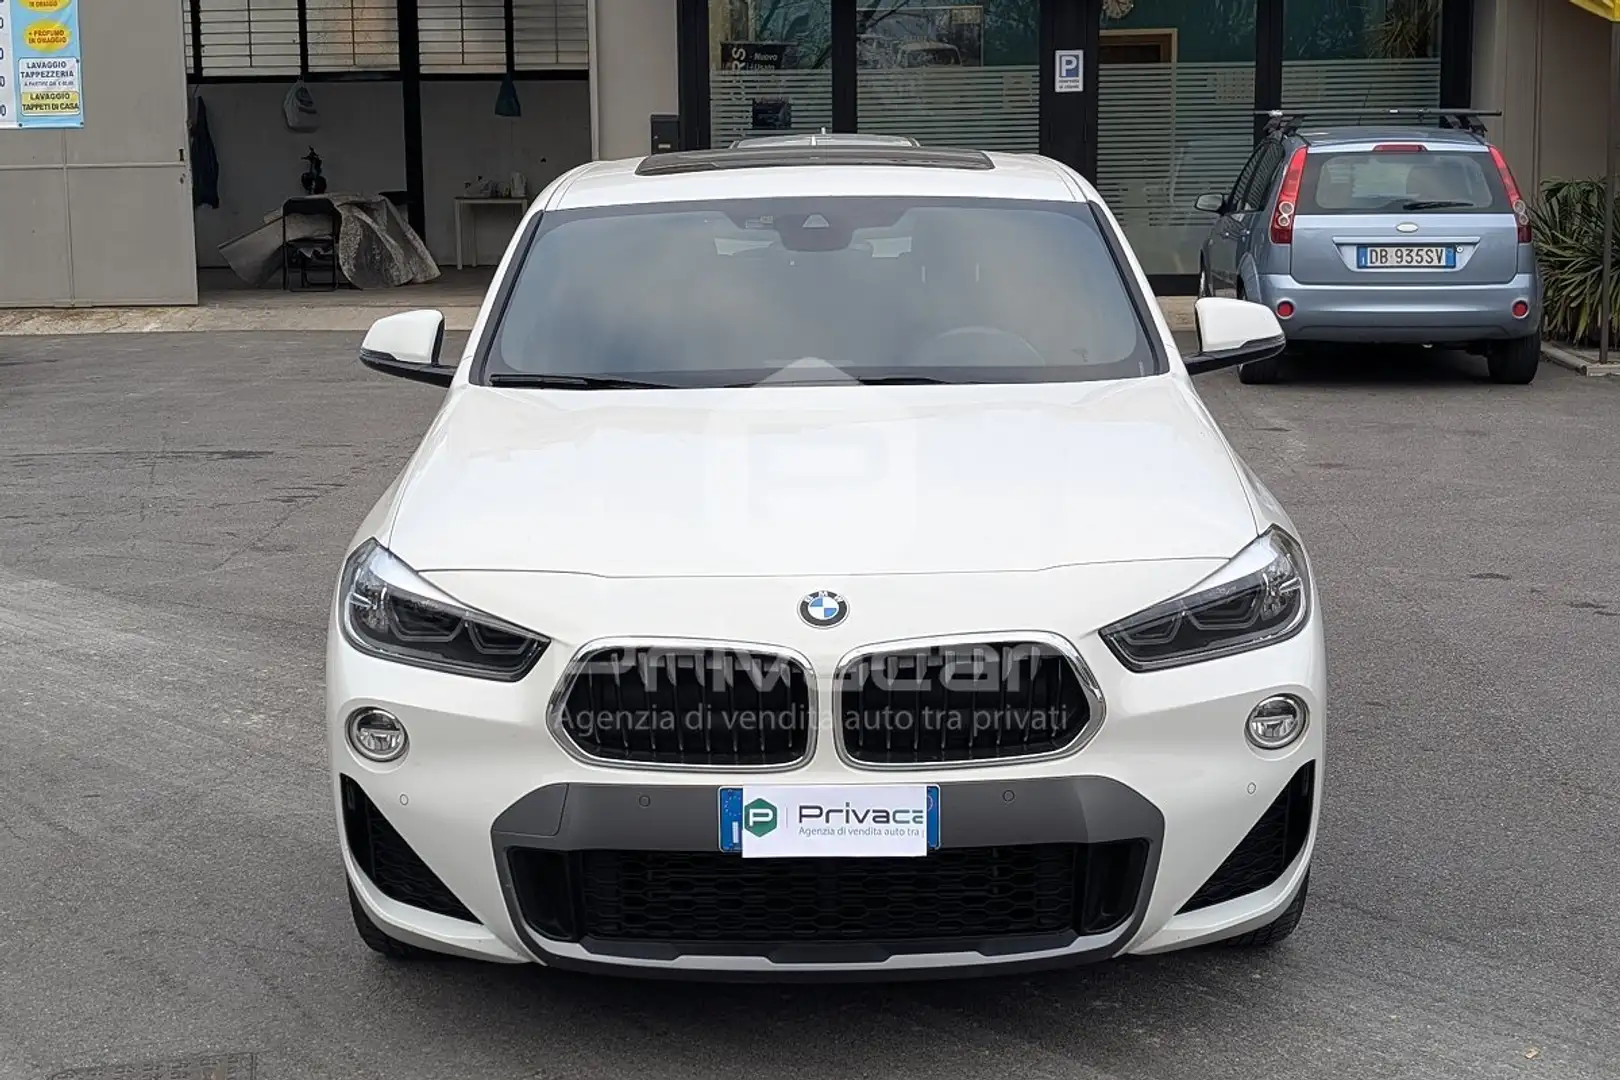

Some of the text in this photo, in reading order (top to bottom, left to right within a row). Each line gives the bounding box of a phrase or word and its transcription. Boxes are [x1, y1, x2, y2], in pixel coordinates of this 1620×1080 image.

[26, 61, 67, 69] LAVAGGIO
[1061, 55, 1077, 77] P
[20, 70, 75, 78] TAPPEZZERIA
[30, 92, 71, 101] LAVAGGIO
[22, 103, 51, 111] TAPPETI
[59, 102, 80, 110] CASA
[1369, 248, 1389, 265] DB
[1394, 248, 1444, 265] 935SV
